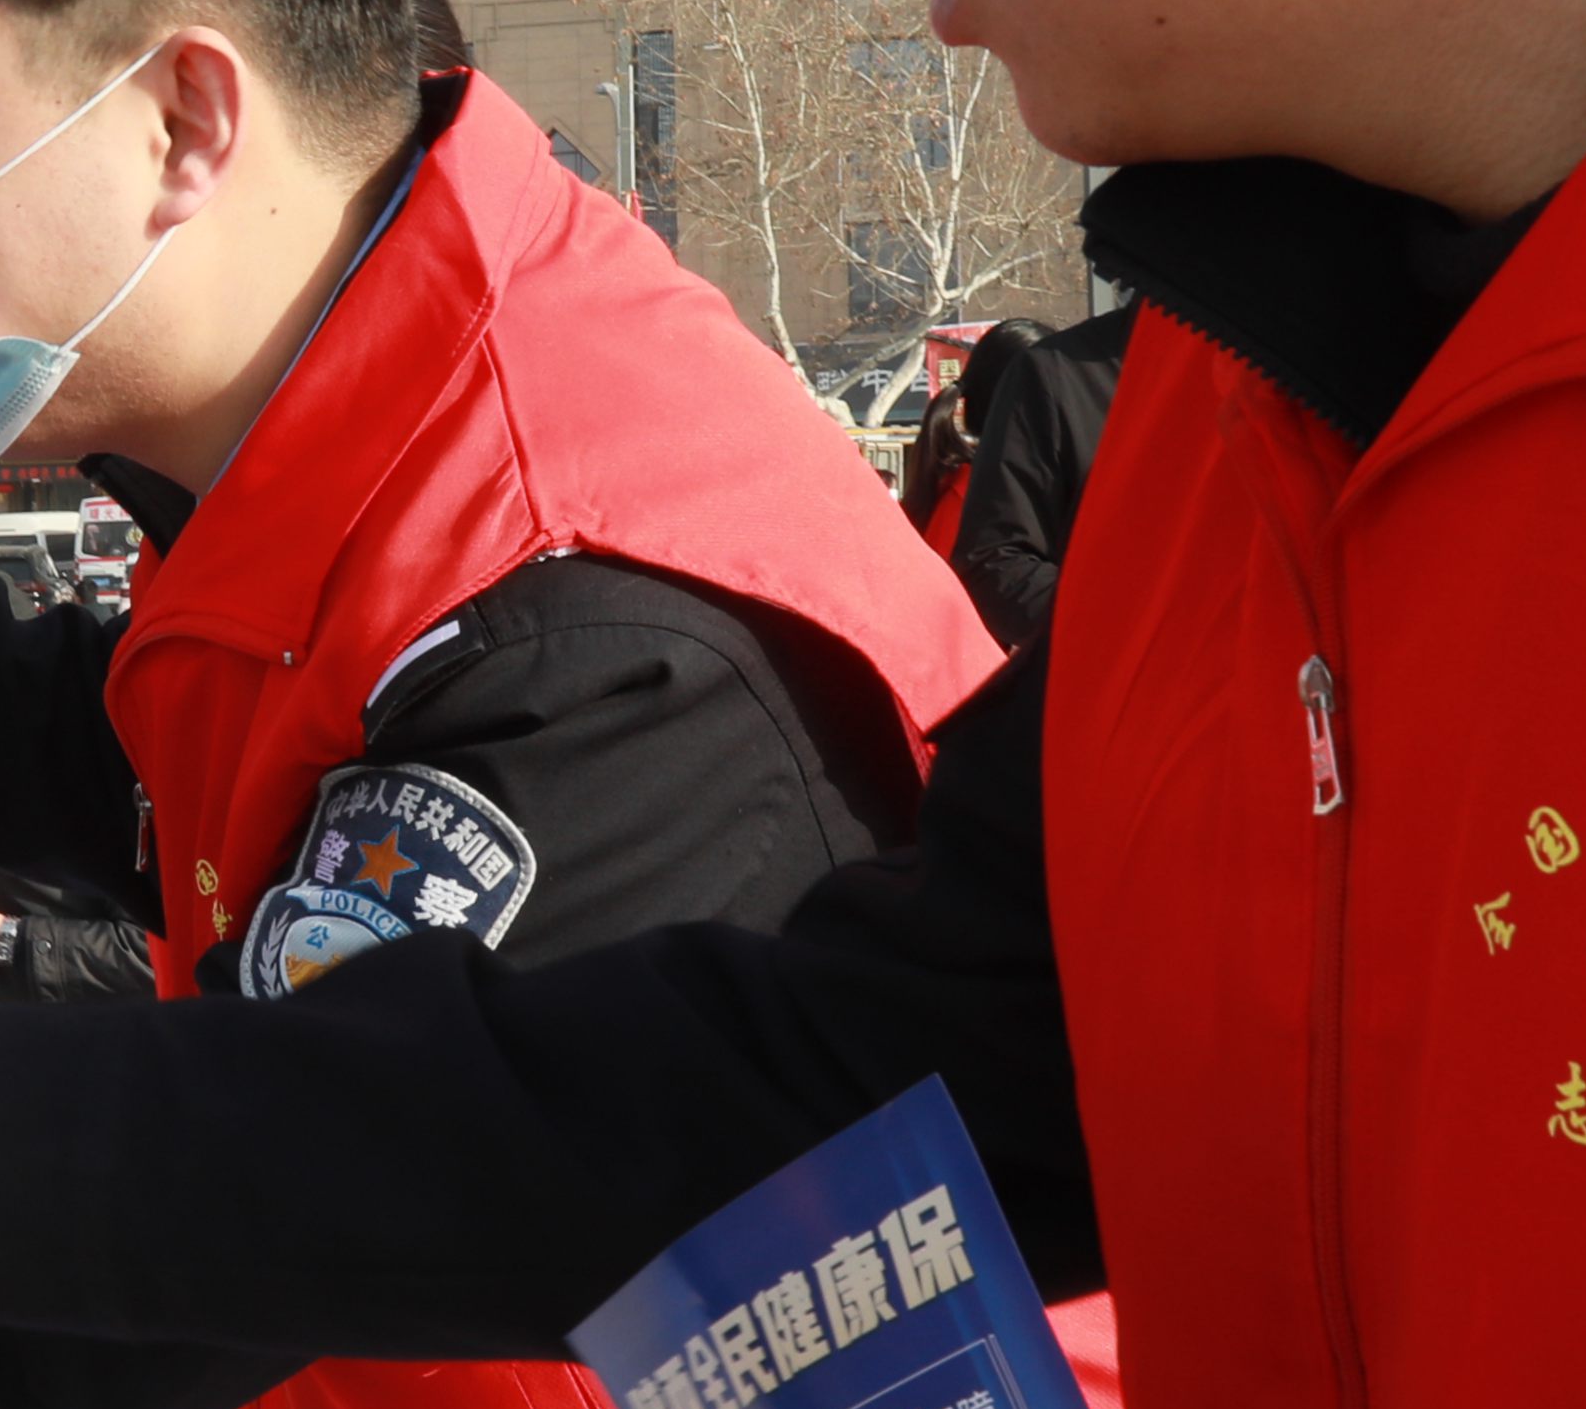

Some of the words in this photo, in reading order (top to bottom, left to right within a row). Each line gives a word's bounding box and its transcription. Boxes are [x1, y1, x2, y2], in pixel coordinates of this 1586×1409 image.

[324, 781, 514, 890] 中华人民共和国
